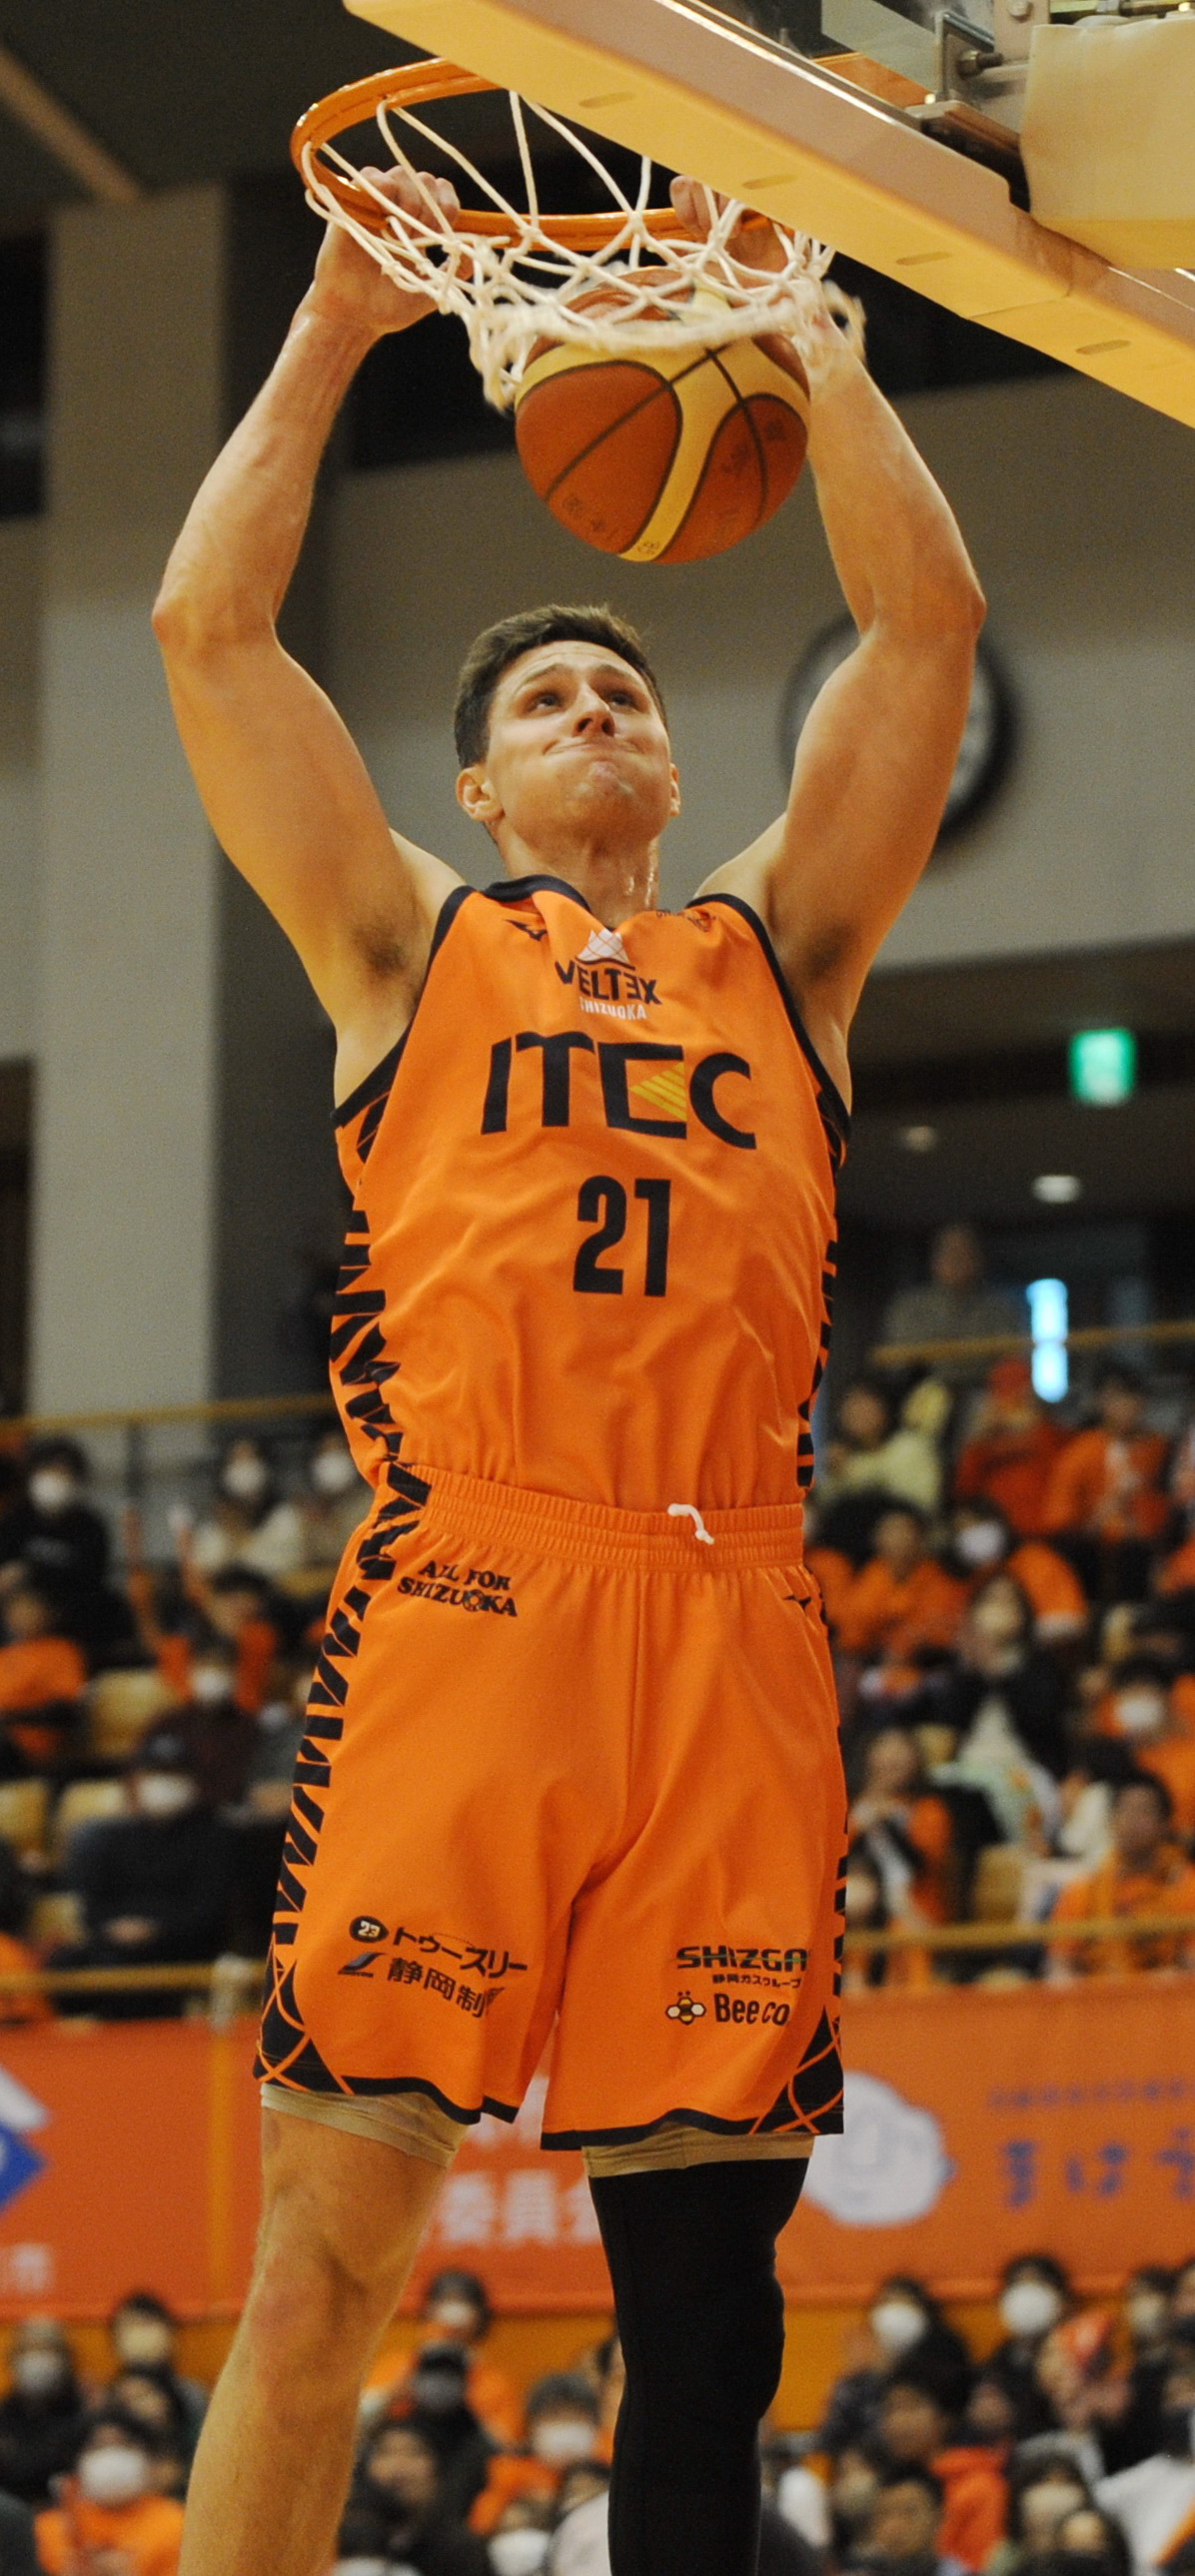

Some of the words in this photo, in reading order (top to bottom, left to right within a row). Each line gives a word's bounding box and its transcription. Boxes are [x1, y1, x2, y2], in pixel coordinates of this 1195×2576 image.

[555, 959, 661, 1005] VELTEX
[482, 1030, 756, 1150] ITEC
[573, 1175, 671, 1297] 21
[419, 1560, 460, 1582] ALL
[464, 1568, 512, 1591] FOR
[398, 1577, 518, 1616] SHIZUOKA
[358, 1921, 381, 1937] 23
[677, 1946, 807, 1971] SHIZGA
[388, 1958, 505, 2018] 静岡制
[713, 1993, 760, 2025] Bee
